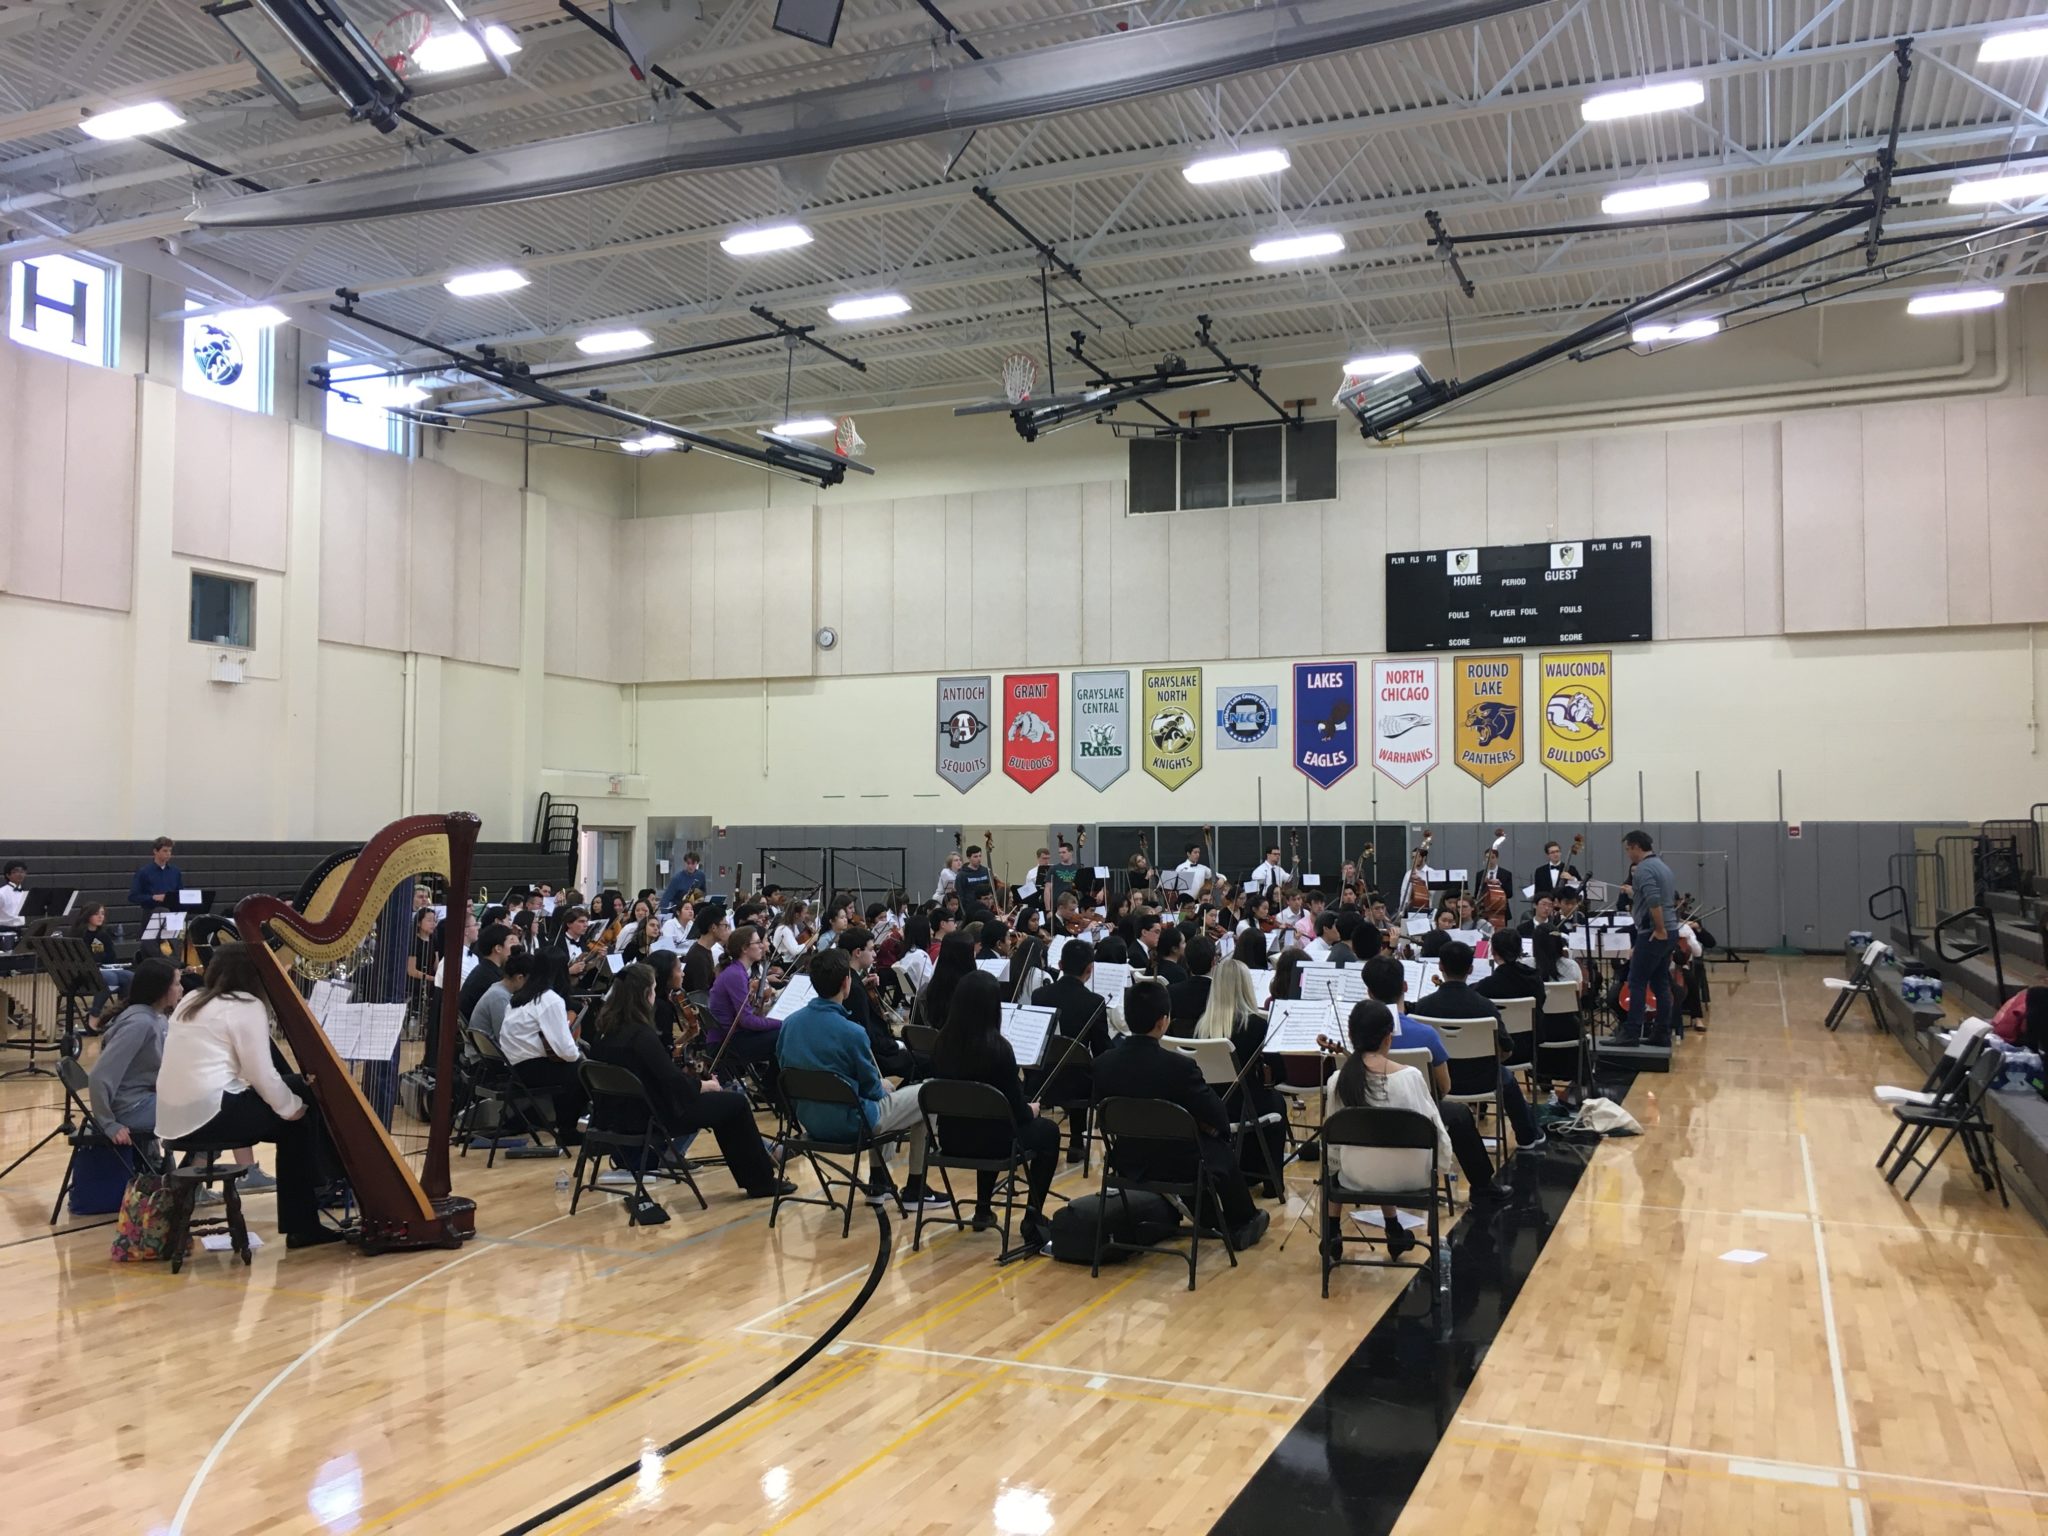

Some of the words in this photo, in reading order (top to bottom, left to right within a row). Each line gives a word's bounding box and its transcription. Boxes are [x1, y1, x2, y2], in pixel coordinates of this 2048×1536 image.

[22, 262, 88, 346] H
[1591, 543, 1606, 552] PLYR
[1613, 542, 1623, 550] FLS
[1631, 540, 1642, 549] PTS
[1391, 557, 1405, 565] PLYR
[1426, 555, 1437, 563] PTS
[1453, 575, 1482, 587] HOME
[1502, 578, 1527, 587] PERIOD
[1545, 569, 1578, 582] GUEST
[1448, 611, 1470, 620] FOULS
[1490, 609, 1516, 618] PLAYER
[1520, 608, 1538, 616] FOUL
[1560, 605, 1582, 614] FOULS
[1448, 638, 1471, 647] SCORE
[1503, 636, 1526, 645] MATCH
[1560, 633, 1583, 642] SCORE
[1468, 663, 1509, 679] ROUND
[1546, 662, 1606, 677] WAUCONDA
[1148, 675, 1197, 689] GRAYSLAKE
[1307, 672, 1343, 689] LAKES
[1386, 671, 1424, 685] NORTH
[943, 687, 985, 700] ANTIOCH
[1014, 684, 1048, 699] GRANT
[1077, 687, 1124, 701] GRAYSLAKE
[1381, 686, 1429, 701] CHICAGO
[1474, 680, 1502, 696] LAKE
[1157, 690, 1187, 702] NORTH
[1082, 702, 1119, 714] CENTRAL
[1229, 711, 1265, 723] NLCC
[1303, 751, 1347, 766] EAGLES
[1379, 748, 1433, 763] WARHAWKS
[1462, 750, 1516, 764] PANTHERS
[1546, 746, 1606, 762] BULLDOGS
[941, 758, 986, 773] SEQUOITS
[1008, 755, 1053, 770] BULLDOGS
[1152, 756, 1193, 770] KNIGHTS
